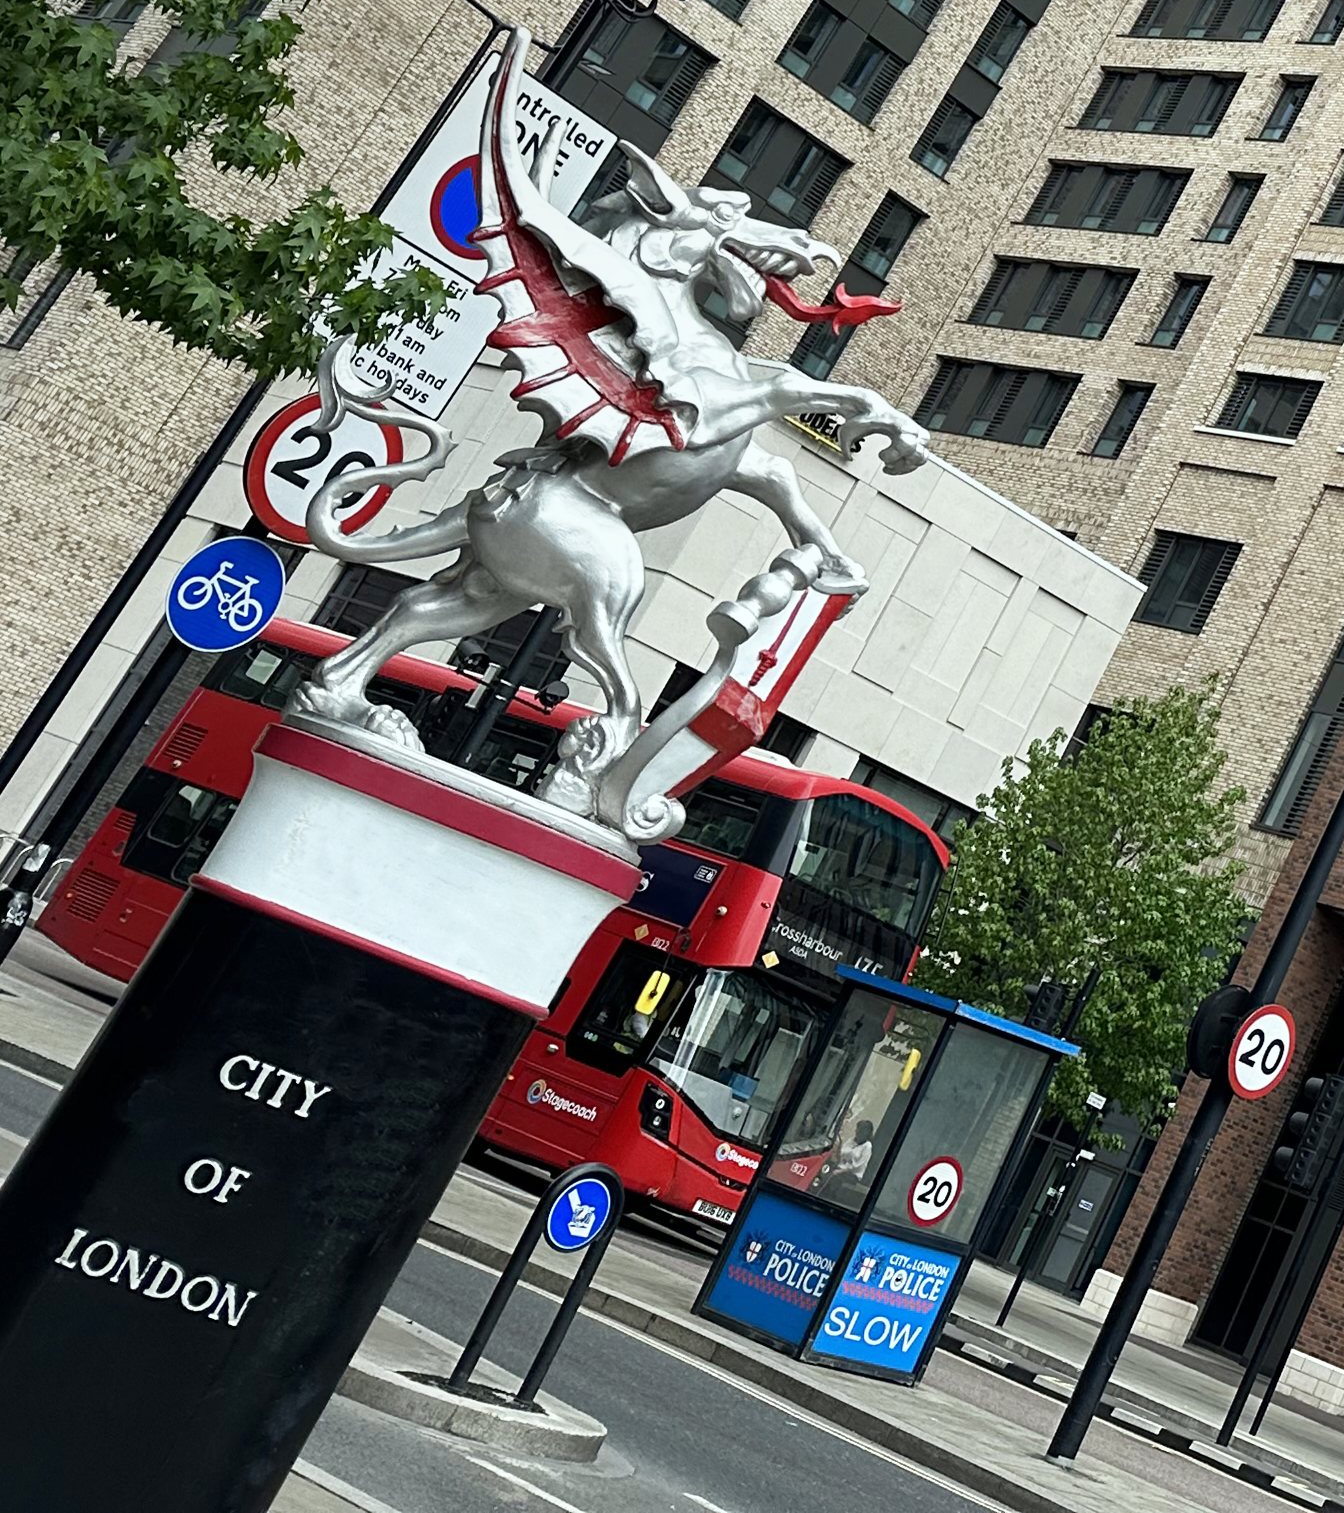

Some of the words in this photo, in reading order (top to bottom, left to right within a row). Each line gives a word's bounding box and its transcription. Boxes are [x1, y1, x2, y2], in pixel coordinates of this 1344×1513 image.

[377, 344, 415, 374] bank
[417, 369, 447, 391] and
[270, 425, 376, 509] 20
[1238, 1028, 1285, 1075] 20
[219, 1054, 332, 1118] CITY
[541, 1088, 597, 1122] Stagecoach
[184, 1158, 252, 1203] OF
[727, 1149, 759, 1170] Stageco
[917, 1176, 952, 1208] 20
[54, 1228, 258, 1327] LONDON
[762, 1253, 830, 1298] POLICE
[774, 1239, 796, 1257] CITY
[796, 1248, 836, 1273] LONDON
[889, 1253, 911, 1268] CITY
[911, 1259, 950, 1279] LONDON
[878, 1266, 945, 1302] POLICE
[824, 1306, 922, 1354] SLOW
